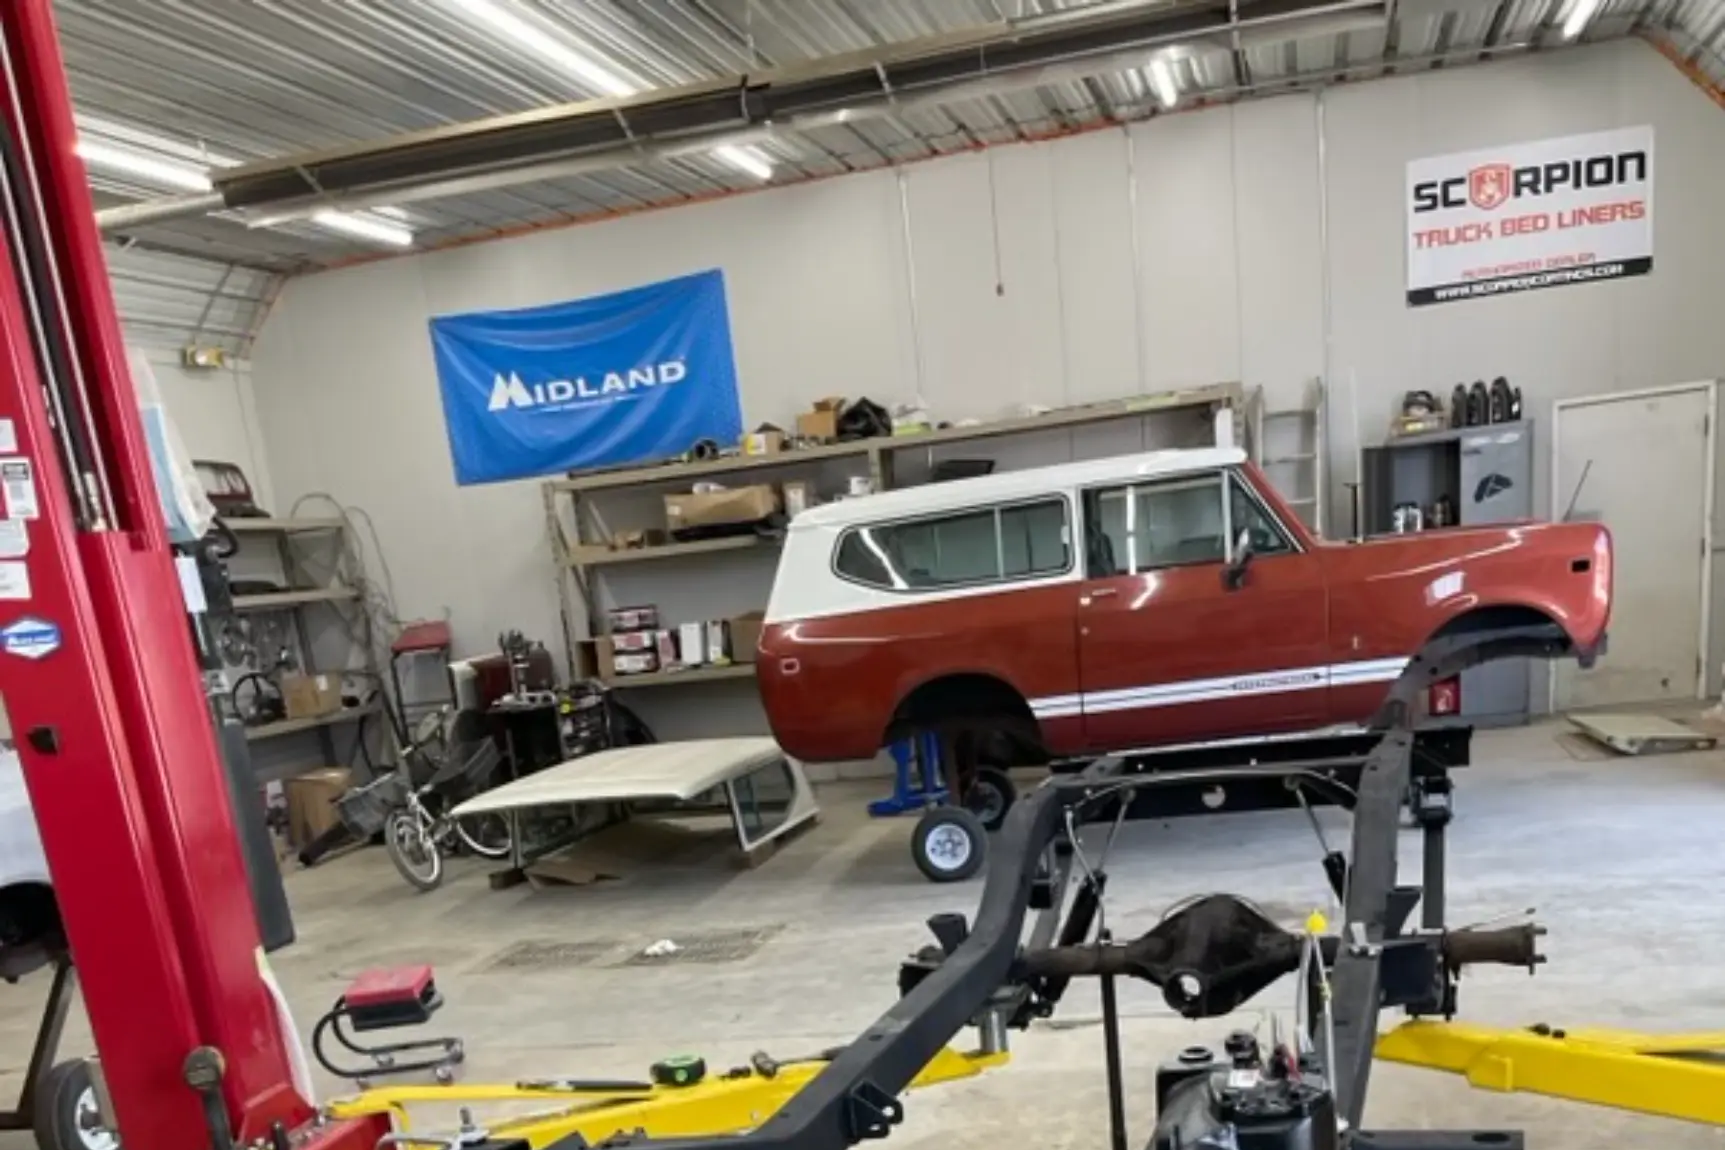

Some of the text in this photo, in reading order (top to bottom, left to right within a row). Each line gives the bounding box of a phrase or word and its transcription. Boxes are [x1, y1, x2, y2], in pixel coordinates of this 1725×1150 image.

[1412, 200, 1646, 249] TRUCK BED LINERS
[487, 360, 687, 412] MIDLAND
